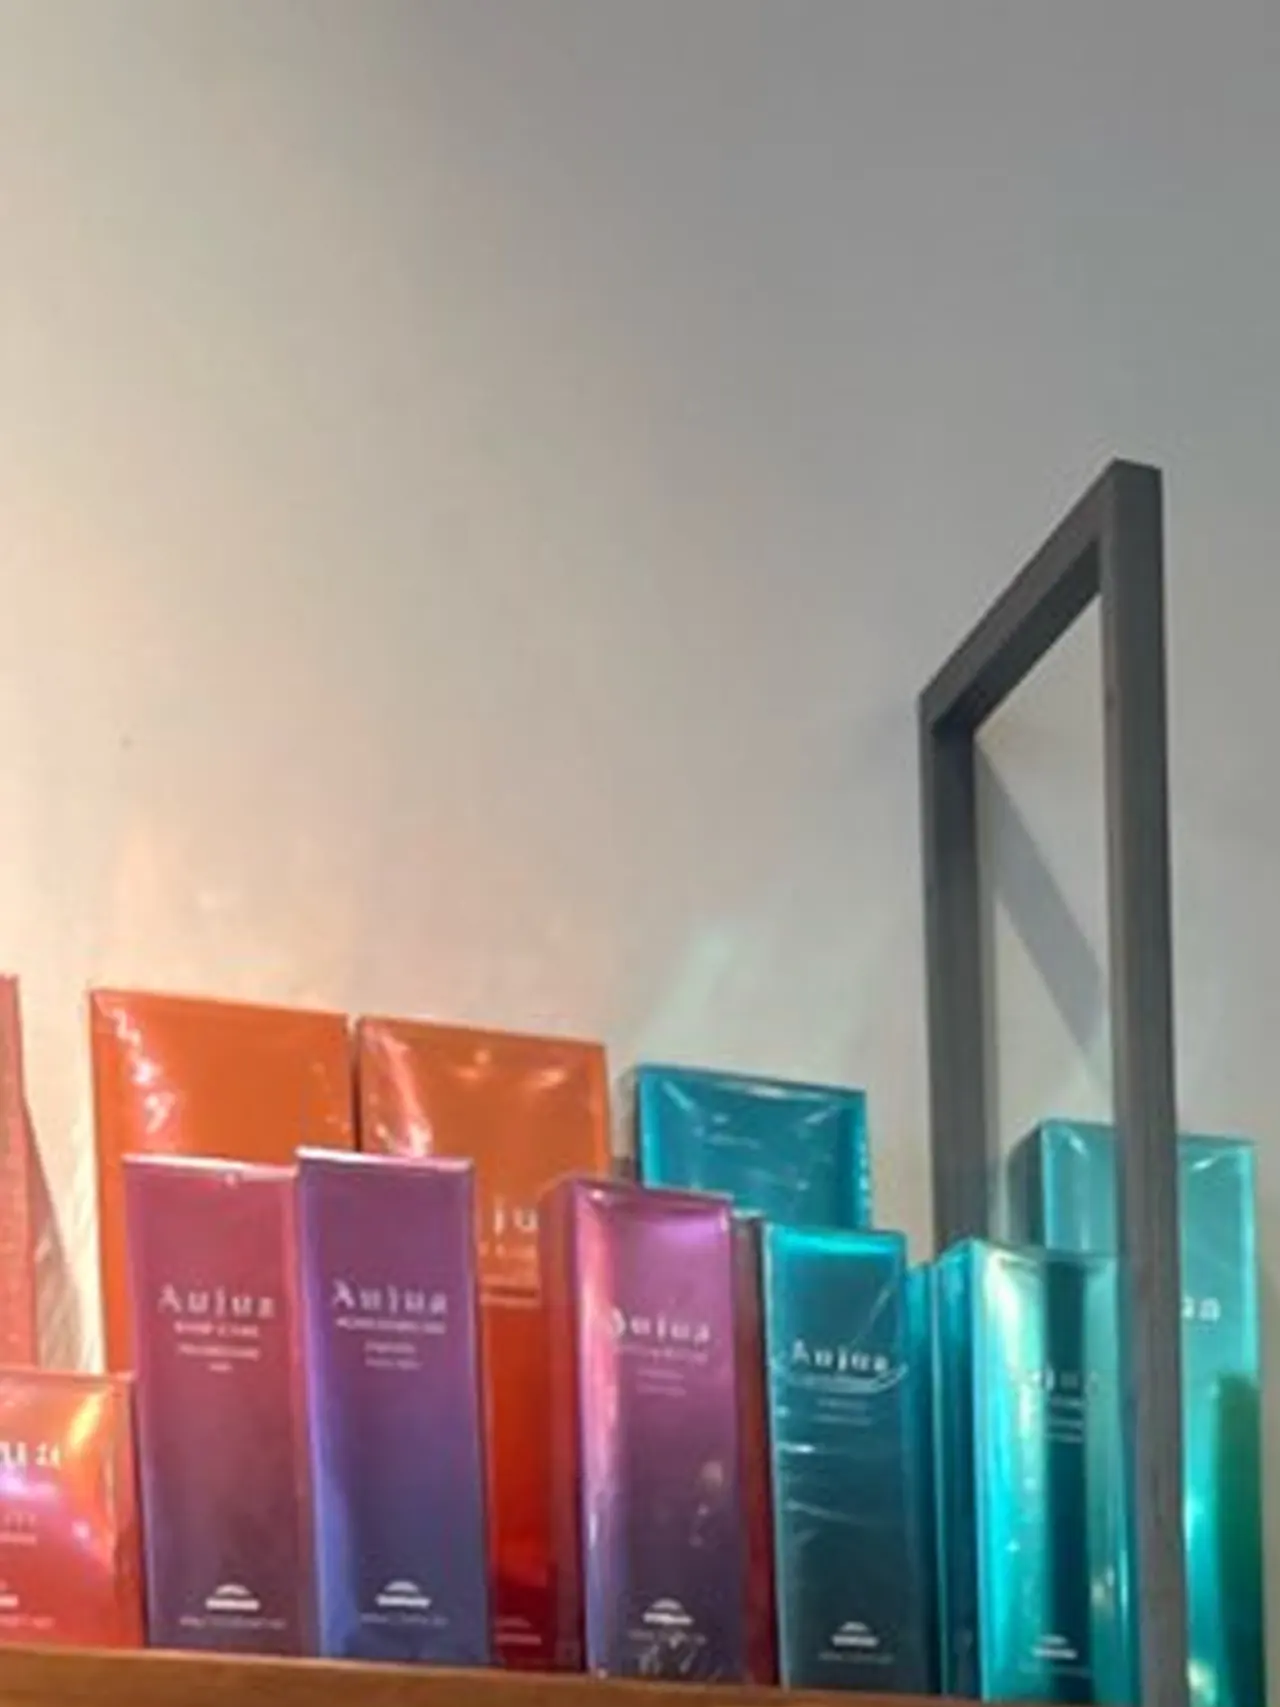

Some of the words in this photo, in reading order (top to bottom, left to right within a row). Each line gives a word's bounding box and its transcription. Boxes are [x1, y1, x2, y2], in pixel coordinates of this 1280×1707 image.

[157, 1282, 276, 1318] Aujua
[333, 1278, 448, 1315] Aujua
[791, 1337, 891, 1373] Aujua
